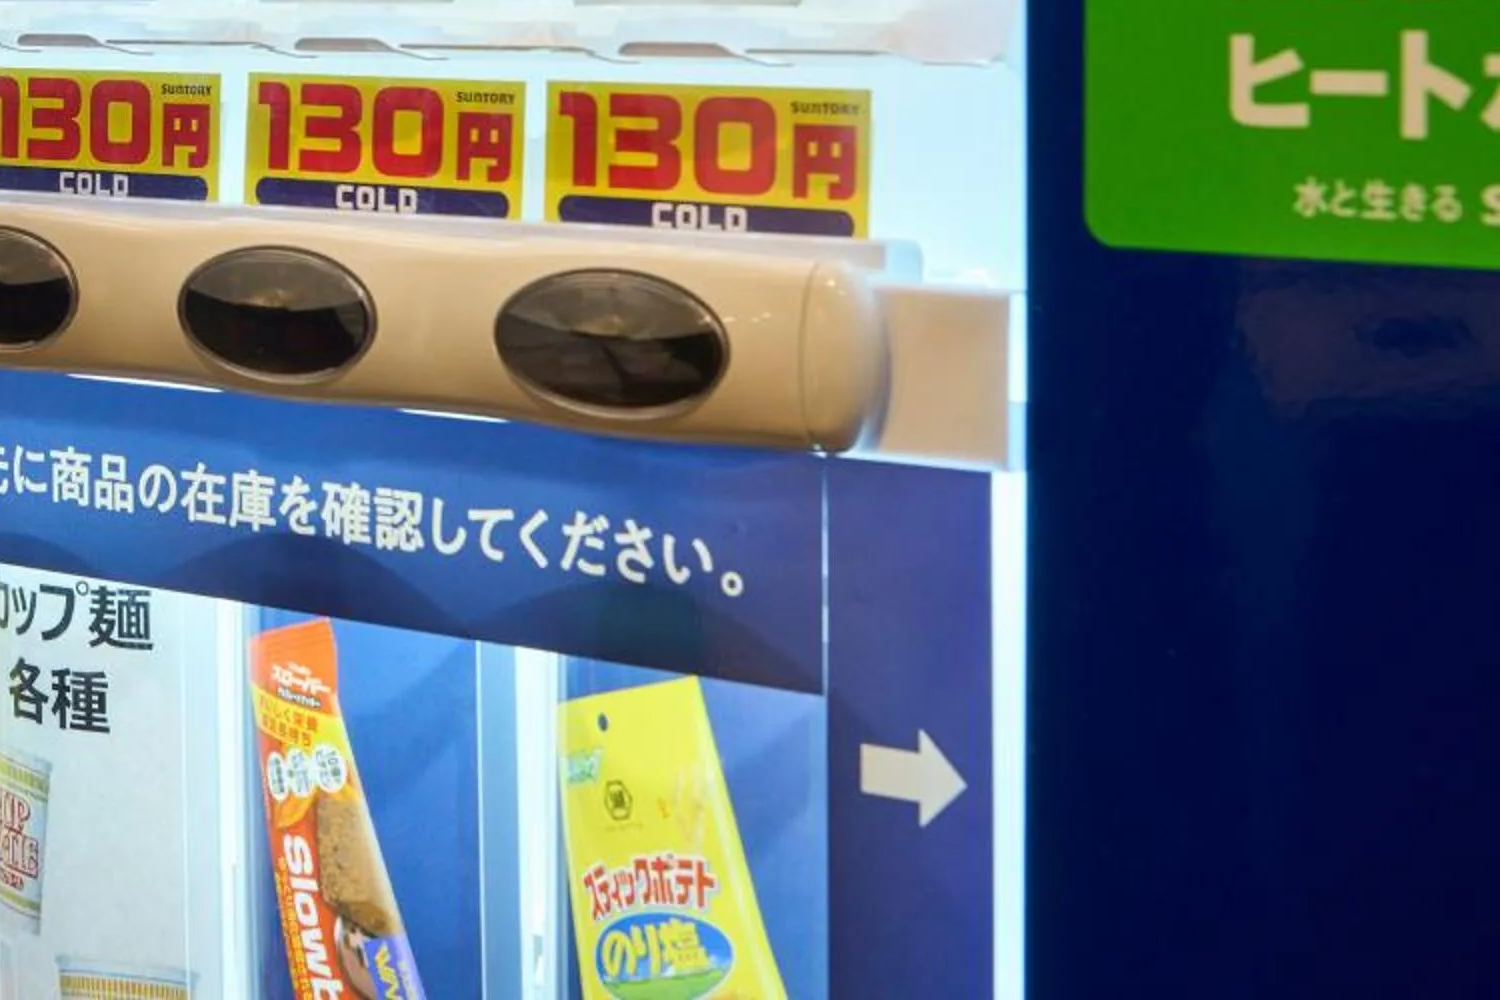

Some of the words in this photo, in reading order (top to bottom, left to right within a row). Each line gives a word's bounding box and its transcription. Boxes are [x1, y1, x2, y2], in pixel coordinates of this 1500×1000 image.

[161, 83, 213, 97] SUNTORY
[456, 91, 516, 105] SUNTORY
[791, 101, 861, 116] SUNTORY
[258, 80, 512, 184] 130円
[559, 90, 858, 201] 130円
[59, 171, 130, 199] COLD
[335, 184, 419, 215] COLD
[1292, 175, 1464, 223] 水と生きる
[650, 202, 749, 233] COLD
[9, 656, 111, 734] 各種
[583, 854, 717, 922] スティックポテト
[601, 918, 712, 979] のり塩
